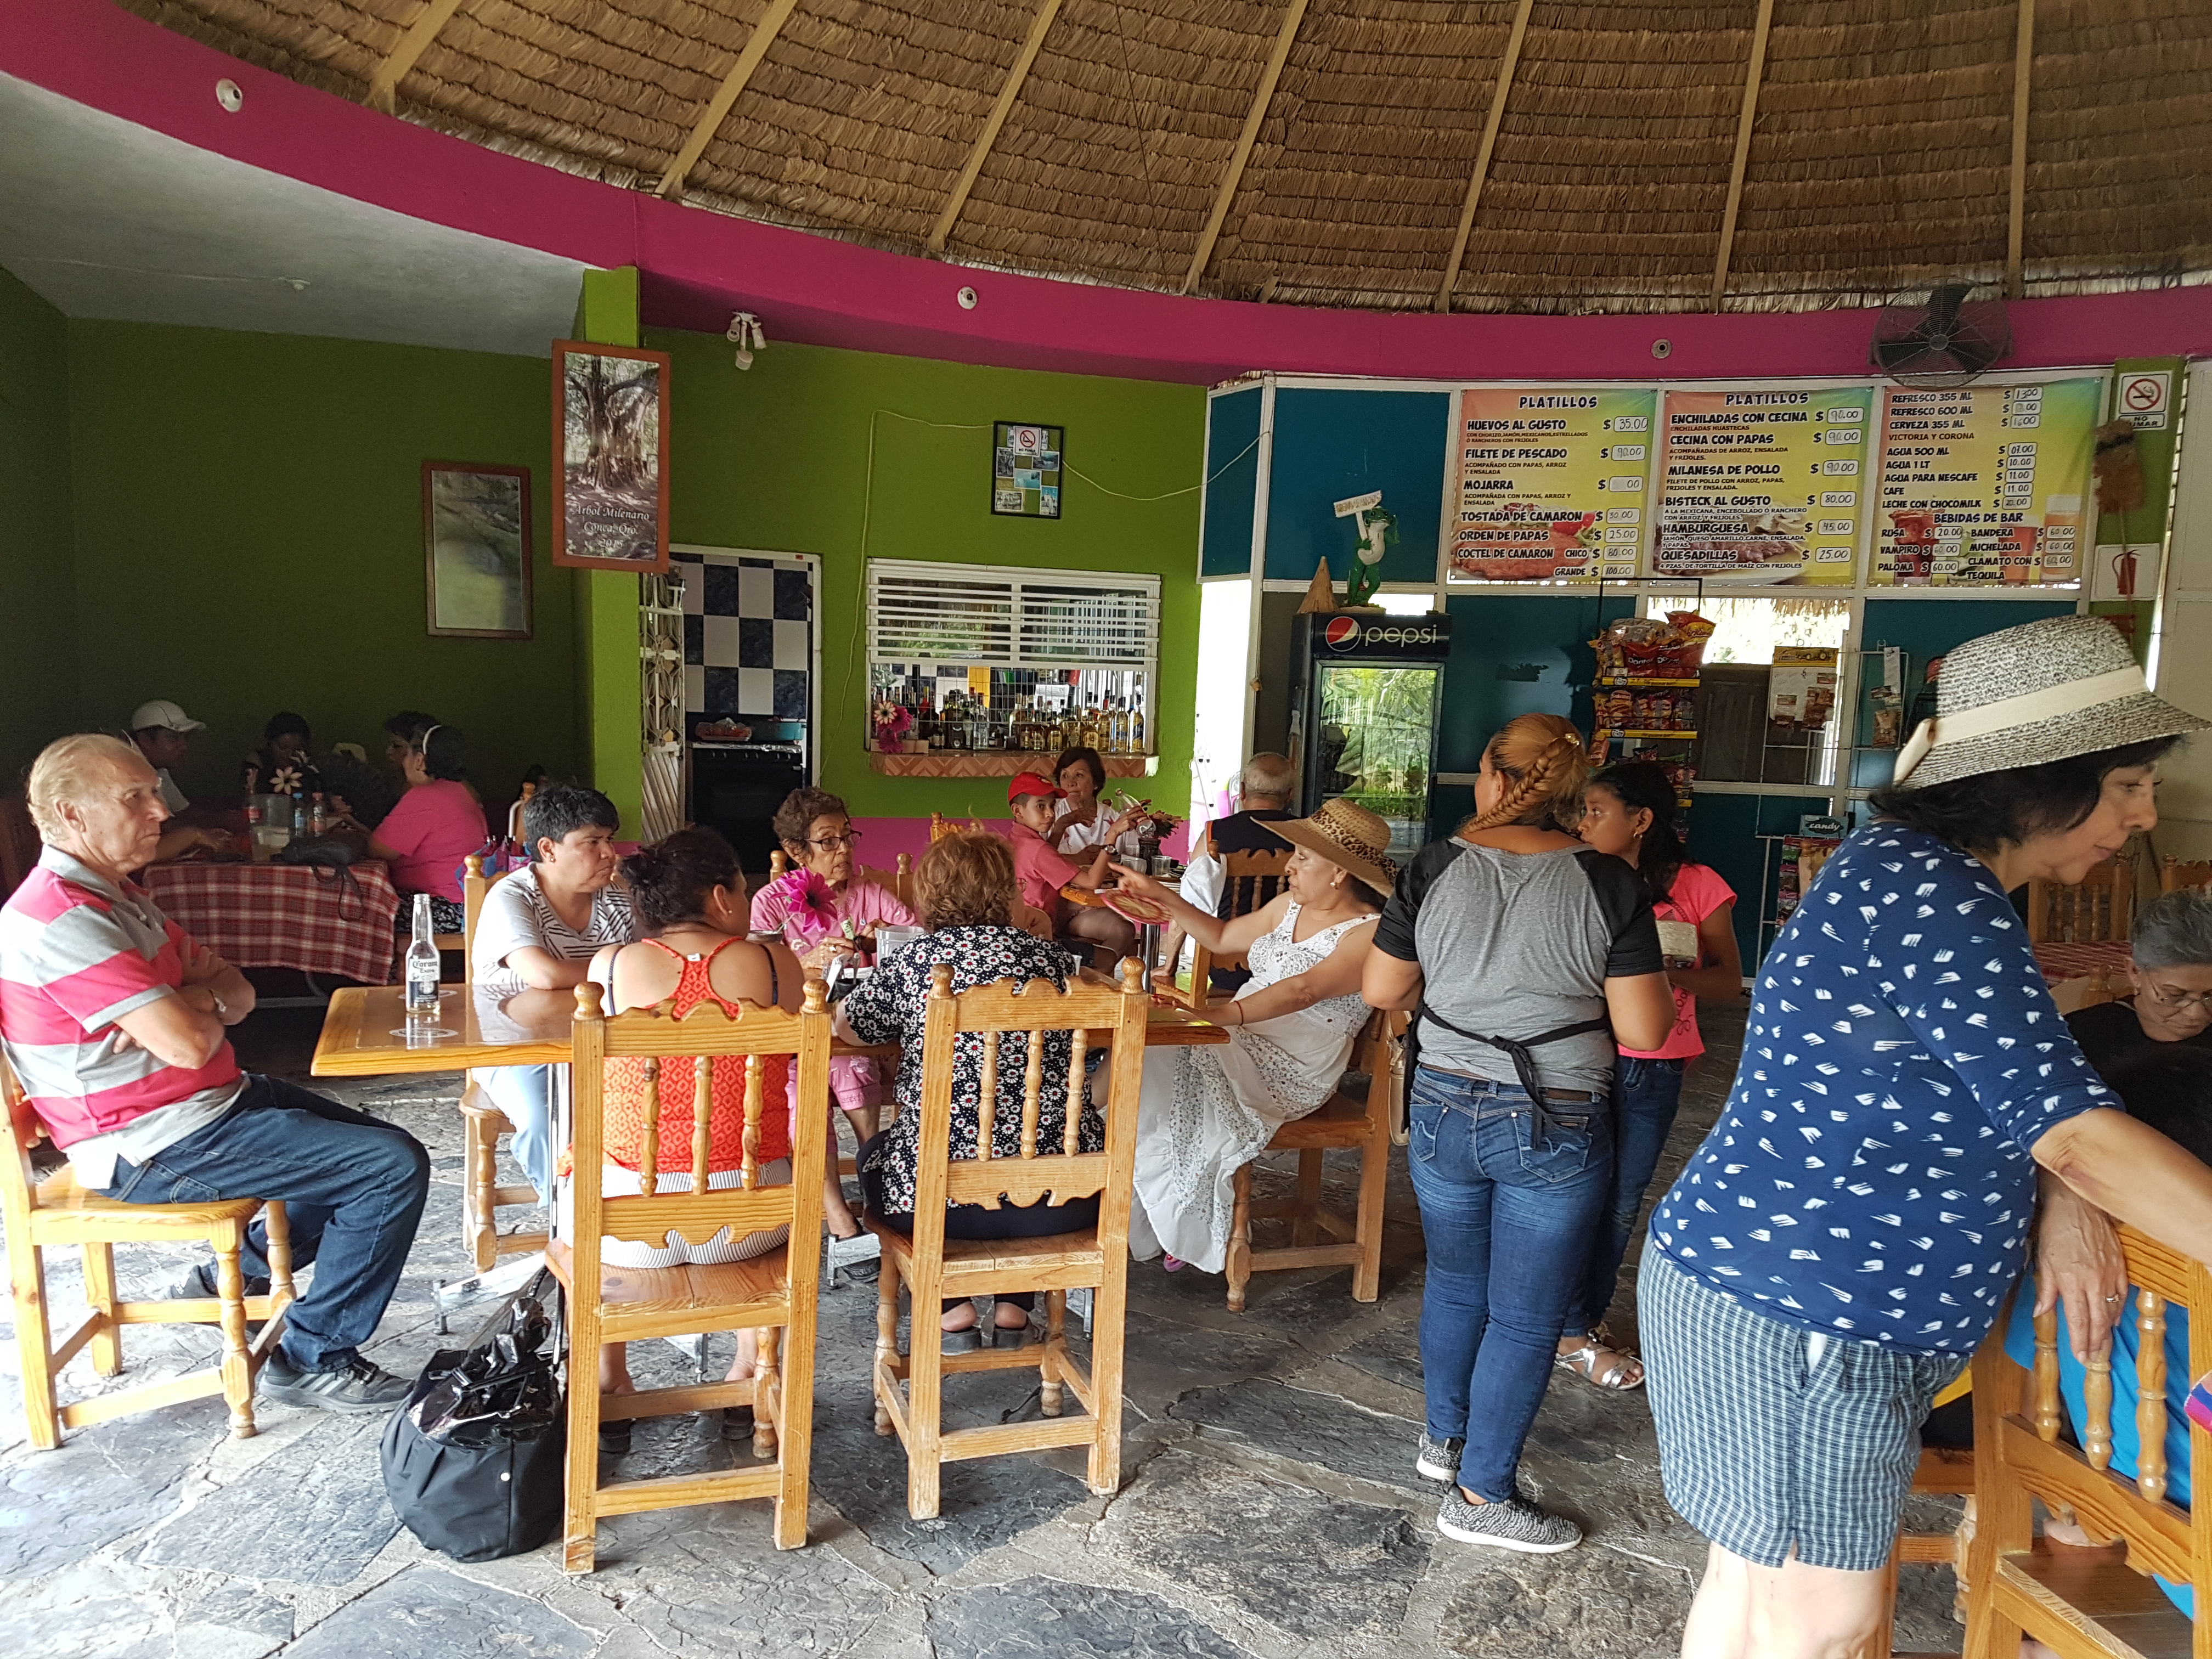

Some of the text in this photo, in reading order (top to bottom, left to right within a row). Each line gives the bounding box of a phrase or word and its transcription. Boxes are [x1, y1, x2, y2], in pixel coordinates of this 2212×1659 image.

[1519, 396, 1597, 408] PLATILLOS
[1725, 393, 1808, 405] PLATILLOS
[1892, 394, 1937, 403] REFRESCO
[1959, 392, 1973, 400] ML
[1891, 406, 1973, 416] REFRESCO 600 ML
[1671, 412, 1808, 424] ENCHILADAS CON CECINA
[1467, 417, 1649, 430] HUEVOS AL GUSTO 35.00
[1889, 420, 1965, 430] CERVEZA 355 ML
[1670, 434, 1774, 444] CECINA CON PAPAS
[1465, 448, 1567, 459] FILETE DE PESCADO
[1887, 448, 1912, 456] AGUA
[1914, 447, 1934, 455] 500
[1936, 447, 1950, 455] ML
[1886, 461, 1911, 469] AGUA
[1920, 460, 1931, 469] LT
[2009, 458, 2031, 466] 10.00
[1668, 466, 1724, 476] MILANESA
[1728, 465, 1742, 475] DE
[1745, 465, 1780, 475] POLLO
[1884, 474, 1909, 482] AGUA
[1912, 473, 1936, 482] PARA
[1938, 473, 1978, 482] NESCAFE
[1463, 480, 1514, 490] MOJARRA
[2007, 484, 2029, 493] 11.00
[1666, 495, 1852, 506] BISTECK AL GUSTO 80.00
[1930, 500, 1982, 508] CHOCOMILK
[603, 507, 650, 520] Milenario
[1461, 511, 1582, 521] TOSTADA DE CAMARON
[1934, 512, 2023, 523] BEBIDAS DE BAR
[1663, 523, 1748, 533] HAMBURGUESA
[1881, 529, 1905, 537] ROSA
[1971, 528, 2014, 537] BANDERA
[1459, 530, 1636, 540] ORDEN DE PAPAS 25.00
[1880, 546, 1919, 554] VAMPIRO
[1968, 543, 2021, 551] MICHELADA
[1458, 549, 1491, 558] COCTEL
[1494, 549, 1505, 558] DE
[1508, 549, 1554, 558] CAMARON
[1565, 549, 1587, 557] CHICO
[1661, 550, 1848, 561] QUESADILLAS 25.00
[1968, 557, 2032, 565] CLAMATO CON
[1878, 563, 1956, 571] PALOMA 60.00
[1967, 572, 2005, 580] TEQUILA
[1364, 624, 1437, 647] pepsi
[1809, 822, 1841, 831] candy
